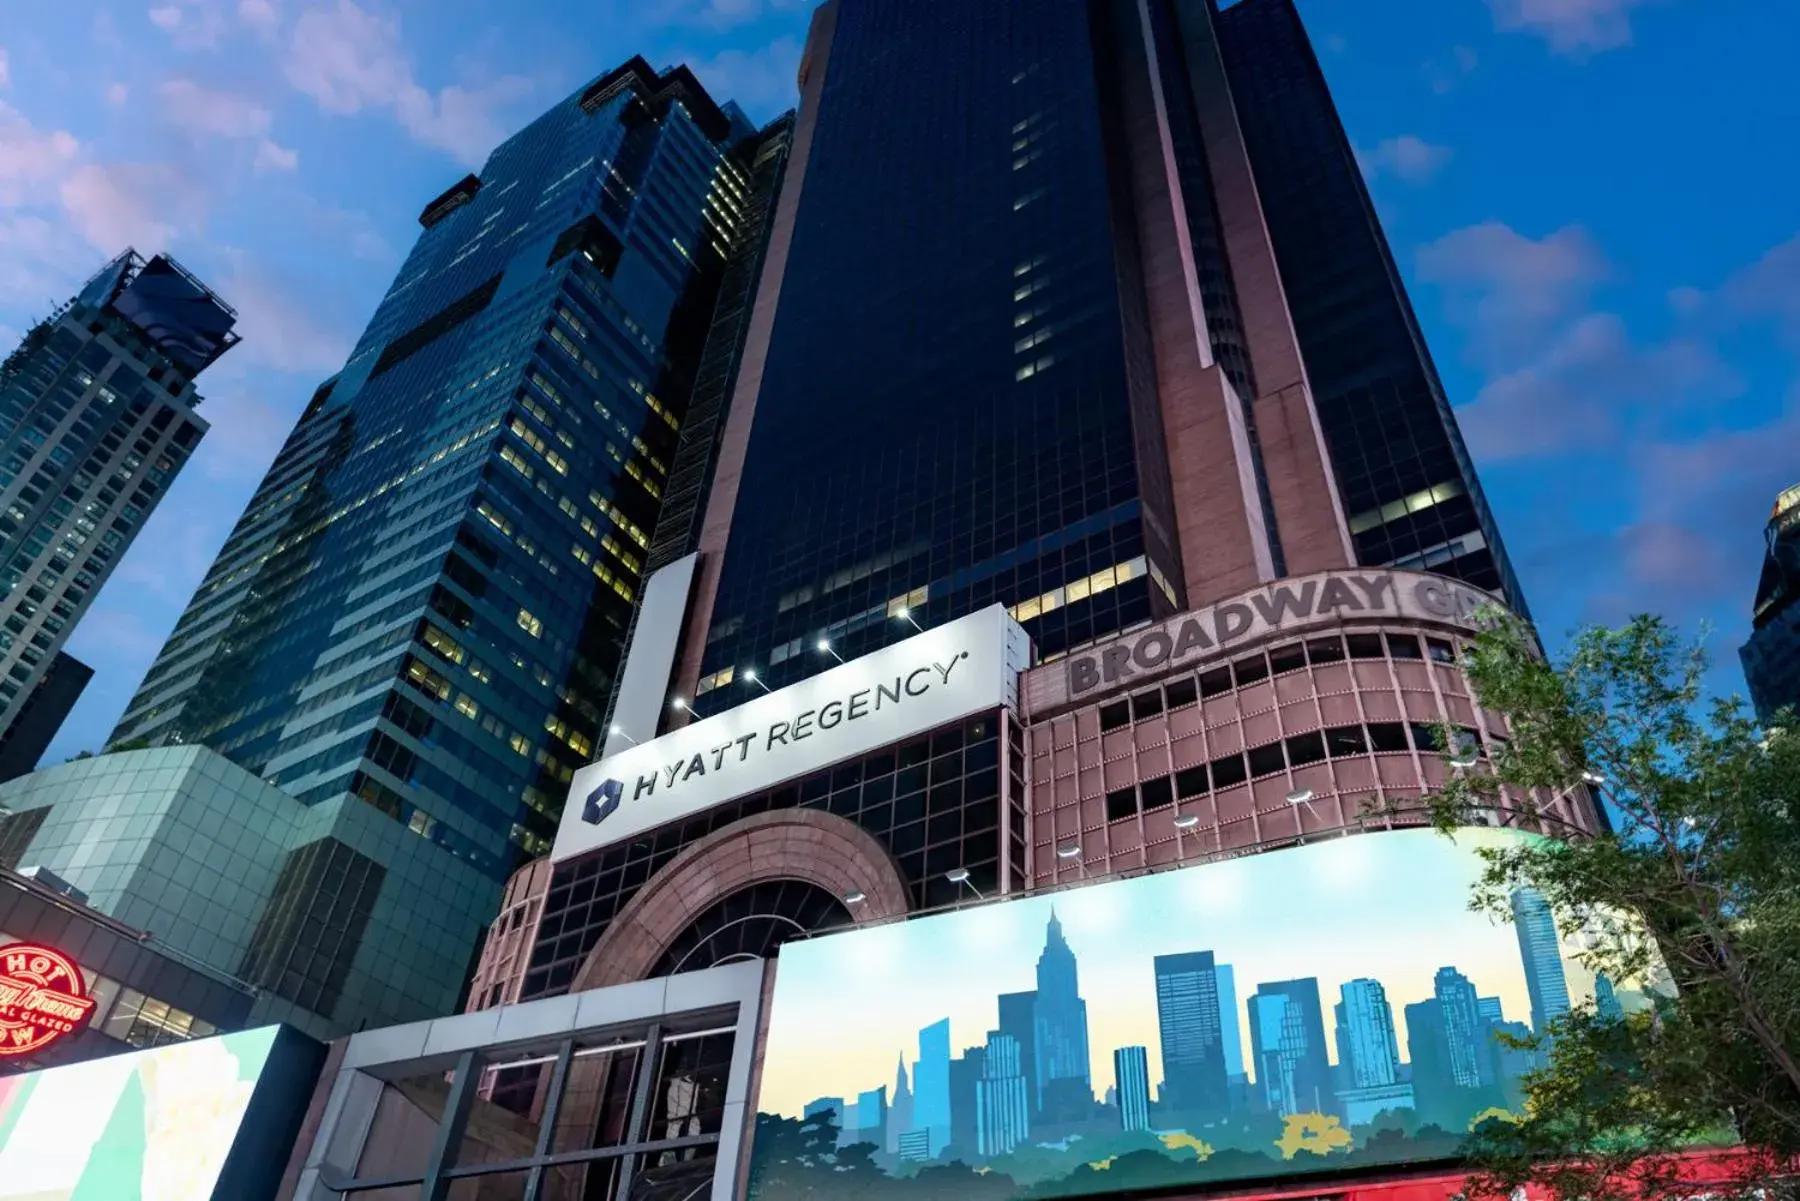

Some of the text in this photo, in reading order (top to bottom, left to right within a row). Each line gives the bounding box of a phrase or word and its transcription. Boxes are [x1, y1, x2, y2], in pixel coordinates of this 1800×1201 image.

[1069, 575, 1392, 694] BROADWAY
[633, 654, 959, 801] HYATT REGENCY
[6, 954, 66, 981] HOT
[21, 1012, 73, 1032] GLAZED
